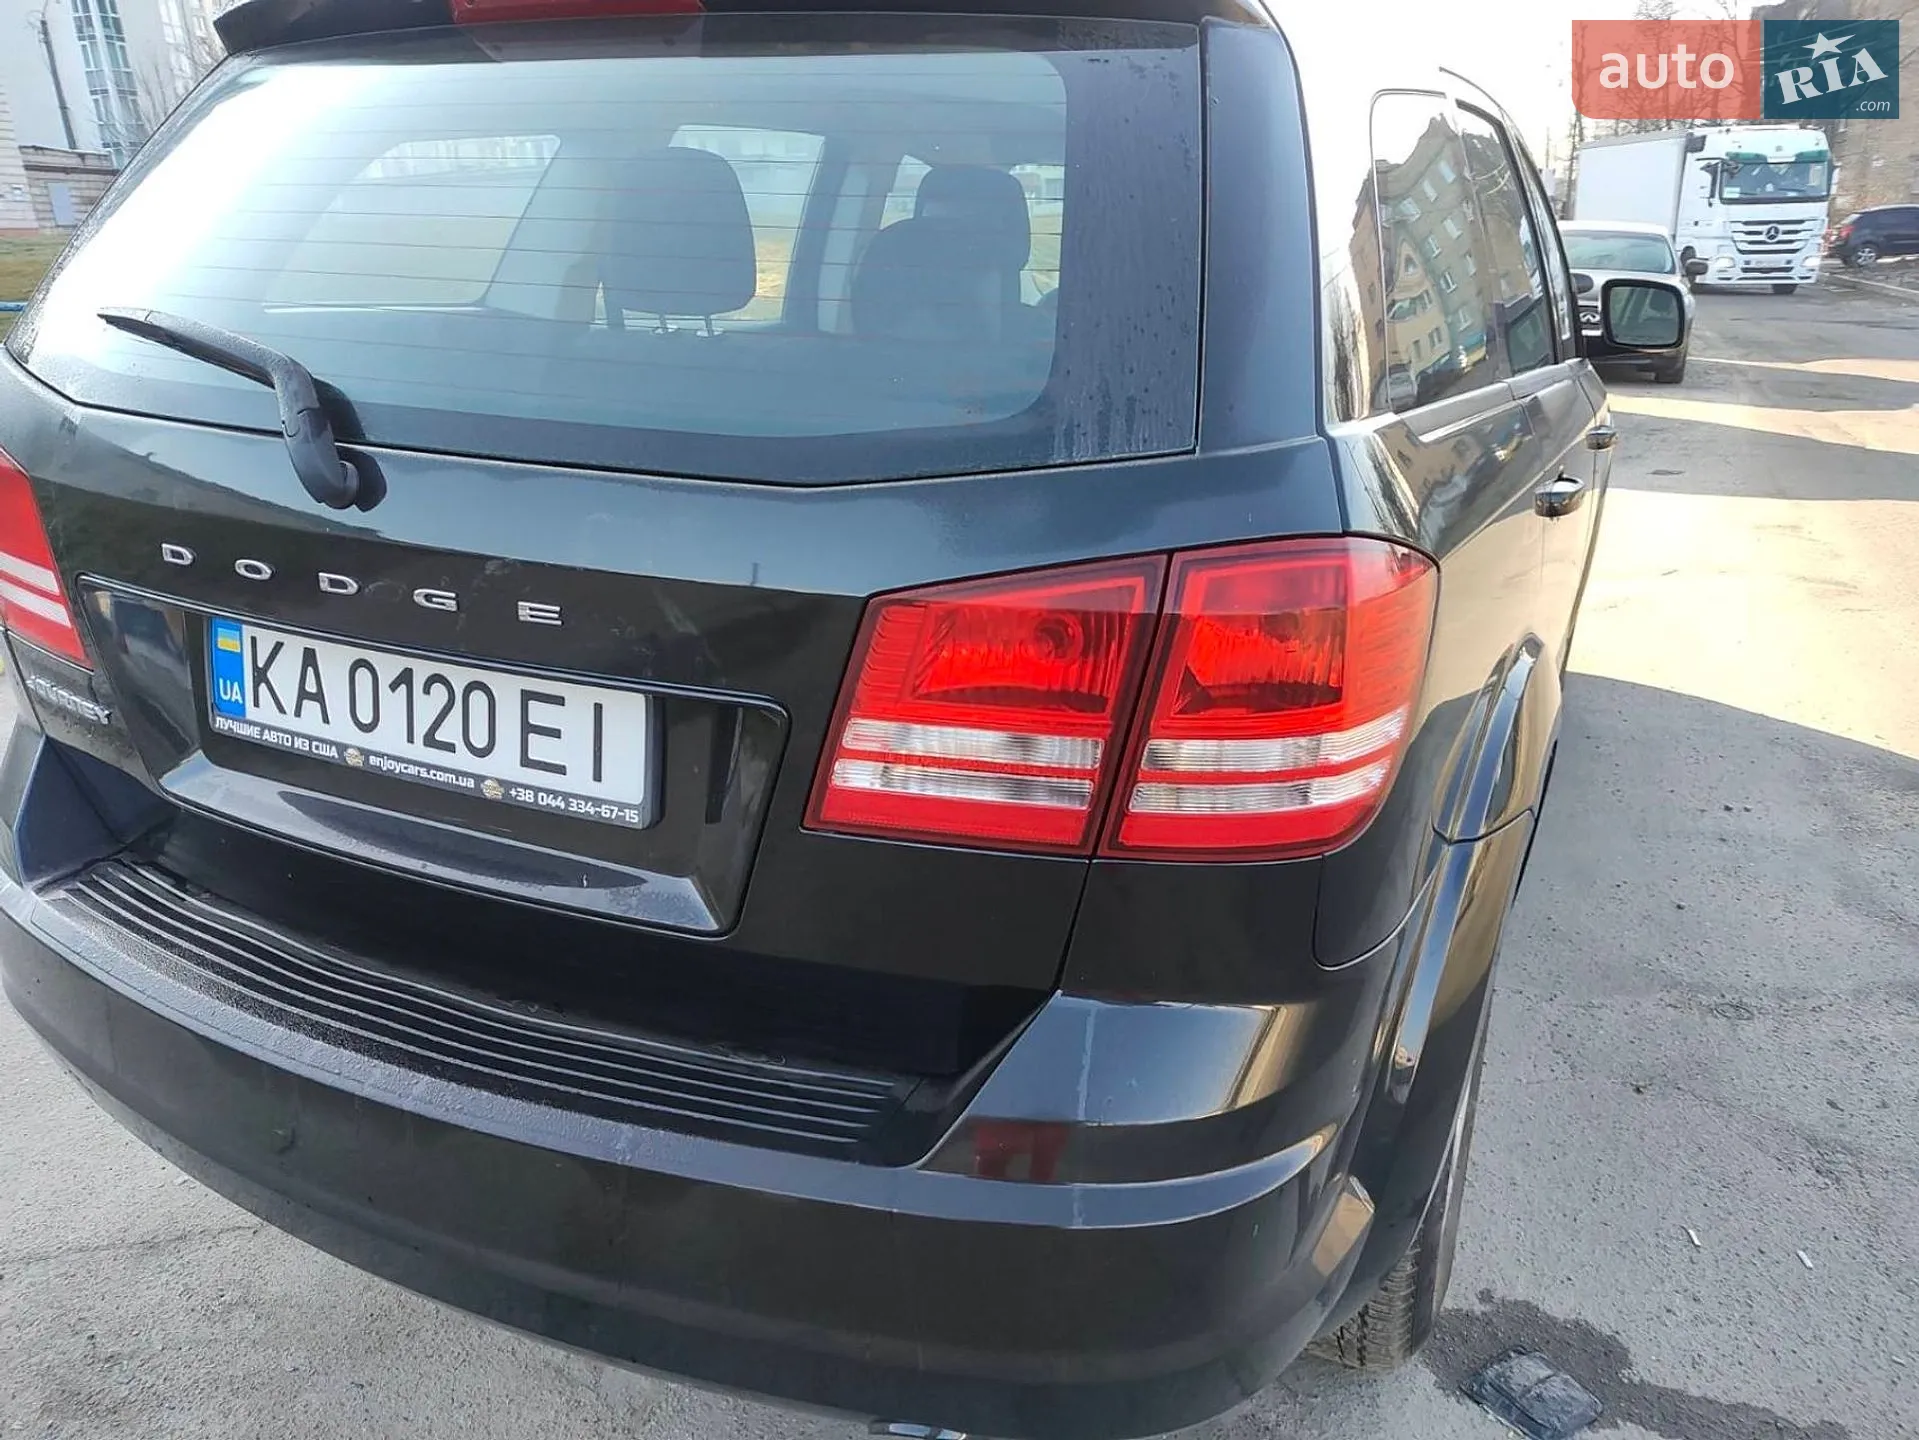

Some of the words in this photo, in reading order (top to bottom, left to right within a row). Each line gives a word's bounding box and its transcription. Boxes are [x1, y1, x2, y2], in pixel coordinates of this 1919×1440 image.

[161, 542, 563, 627] DODGE
[219, 678, 243, 704] UA
[250, 635, 330, 725] KA
[348, 658, 497, 759] 0120
[519, 688, 603, 783] EI
[215, 716, 261, 740] ЛУЧШИЕ
[262, 728, 292, 747] АВТО
[294, 737, 310, 751] ИЗ
[311, 740, 339, 759] США
[368, 755, 475, 790] enjoycars.com.ua
[508, 787, 535, 803] +38
[538, 792, 566, 810] 044
[567, 798, 640, 823] 334-67-15
